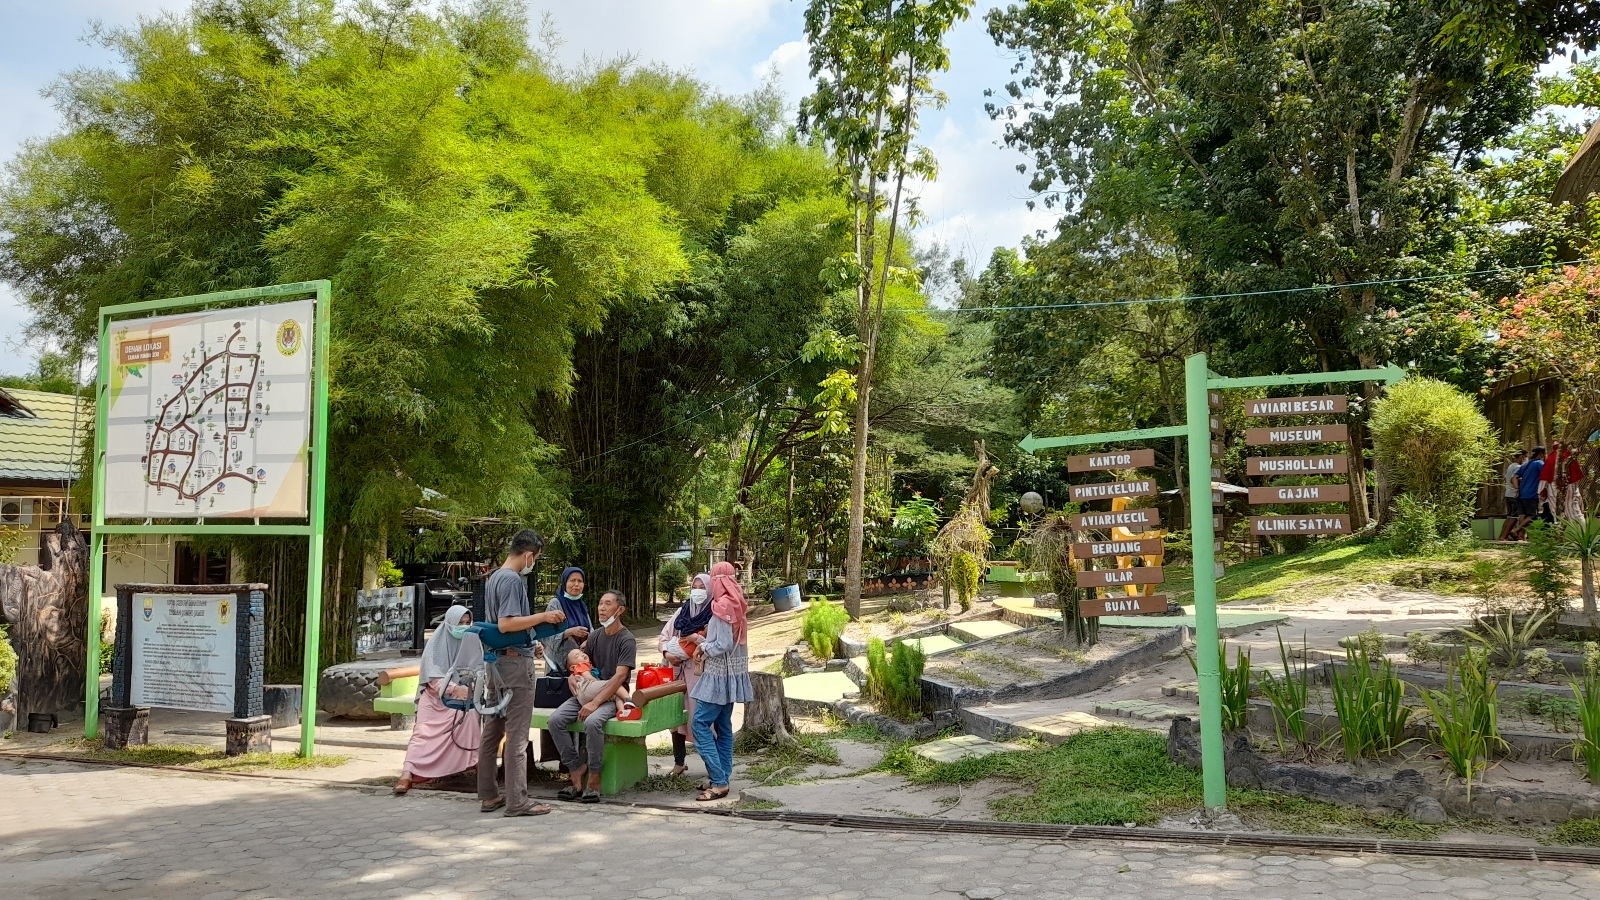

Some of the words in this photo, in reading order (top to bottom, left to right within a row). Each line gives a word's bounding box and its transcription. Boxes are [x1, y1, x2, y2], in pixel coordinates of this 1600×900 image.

[143, 342, 162, 351] LOKASI
[1252, 401, 1292, 414] AVIARI
[1293, 399, 1334, 412] BESAR
[1269, 429, 1322, 442] MUSEUM
[1089, 454, 1131, 467] KANTOR
[1259, 458, 1334, 472] MUSHOLLAH
[1075, 485, 1106, 498] PINTU
[1107, 481, 1149, 495] KELUAR
[1278, 487, 1319, 499] GAJAH
[1081, 514, 1115, 527] AVIARI
[1116, 511, 1149, 524] KECIL
[1257, 519, 1297, 531] KLINIK
[1299, 518, 1342, 530] SATWA
[1091, 541, 1141, 554] BERUANG
[1105, 571, 1133, 582] ULAR
[1104, 599, 1140, 612] BUAYA
